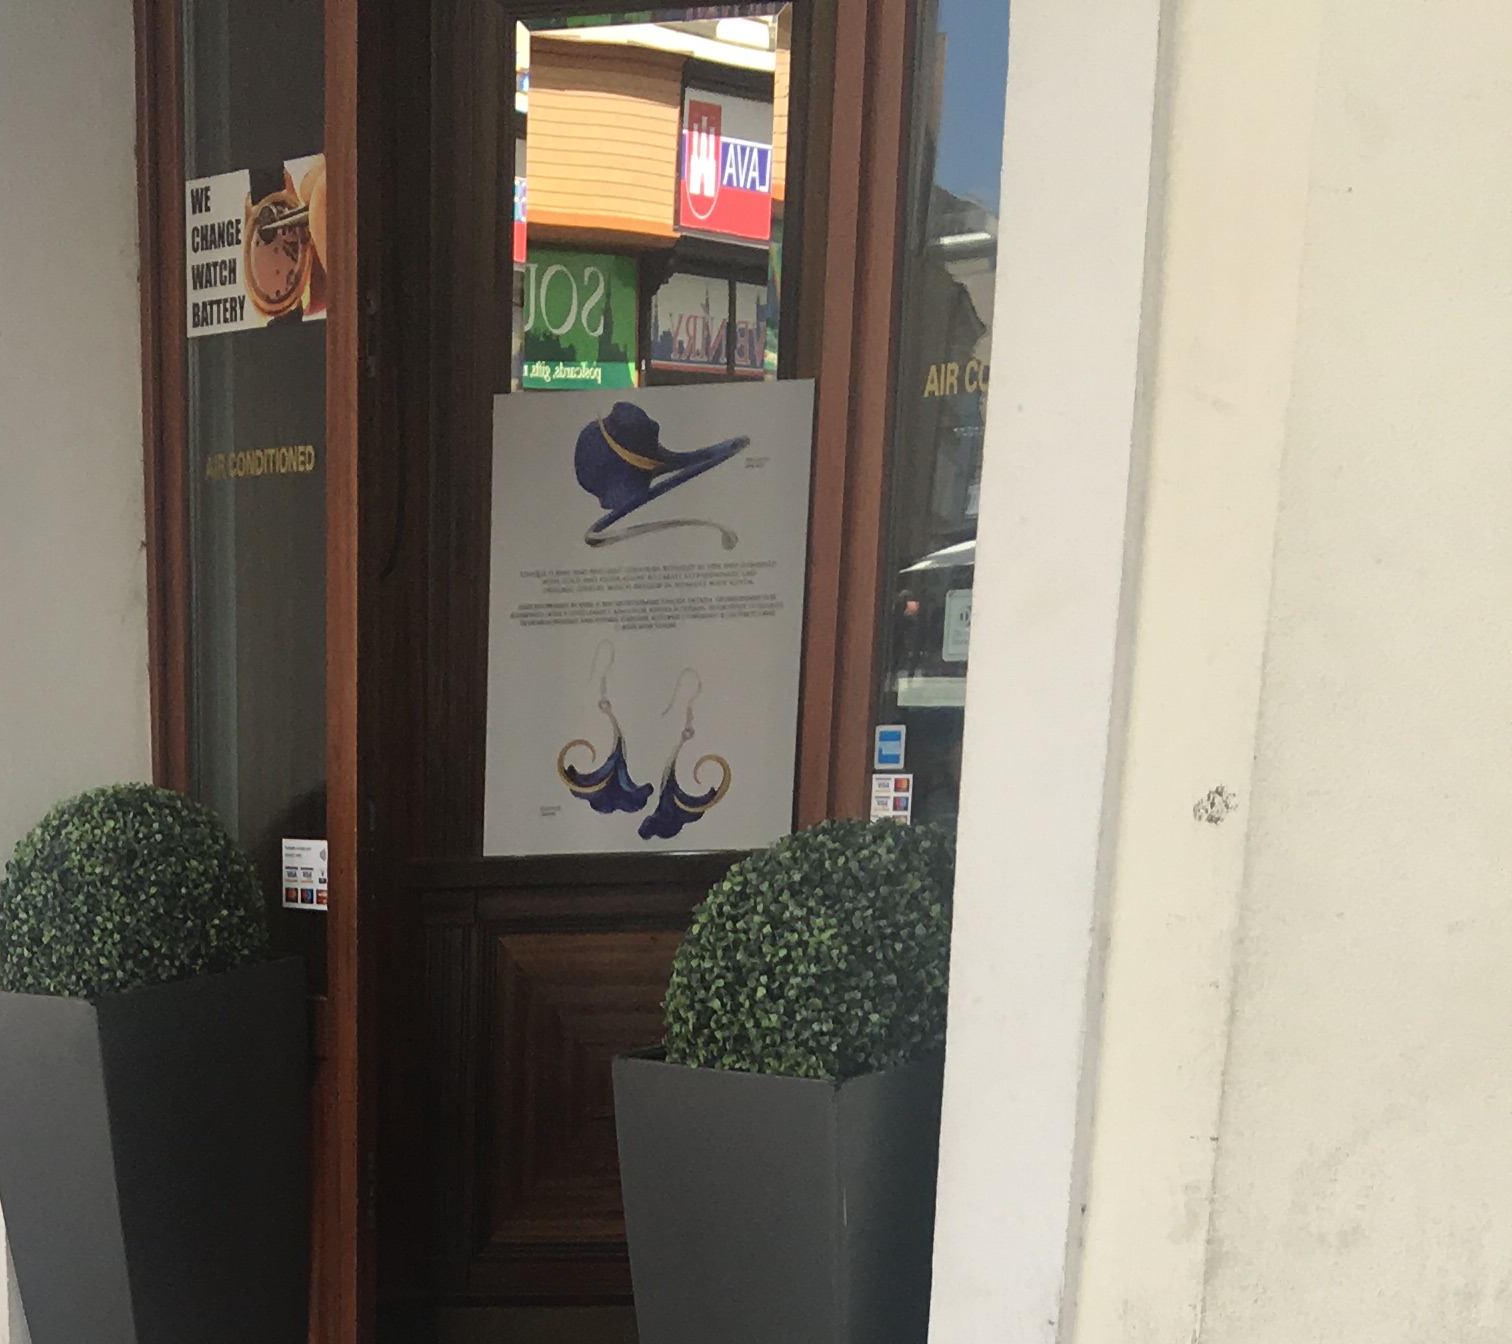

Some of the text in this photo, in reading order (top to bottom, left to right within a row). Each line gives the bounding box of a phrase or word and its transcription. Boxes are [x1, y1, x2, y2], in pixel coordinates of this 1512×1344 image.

[190, 185, 212, 215] WE
[191, 219, 242, 253] CHANGE
[191, 258, 238, 290] WATCH
[192, 295, 246, 328] BATTERY
[923, 362, 959, 398] AIR
[205, 445, 316, 481] AIR CONDITIONED
